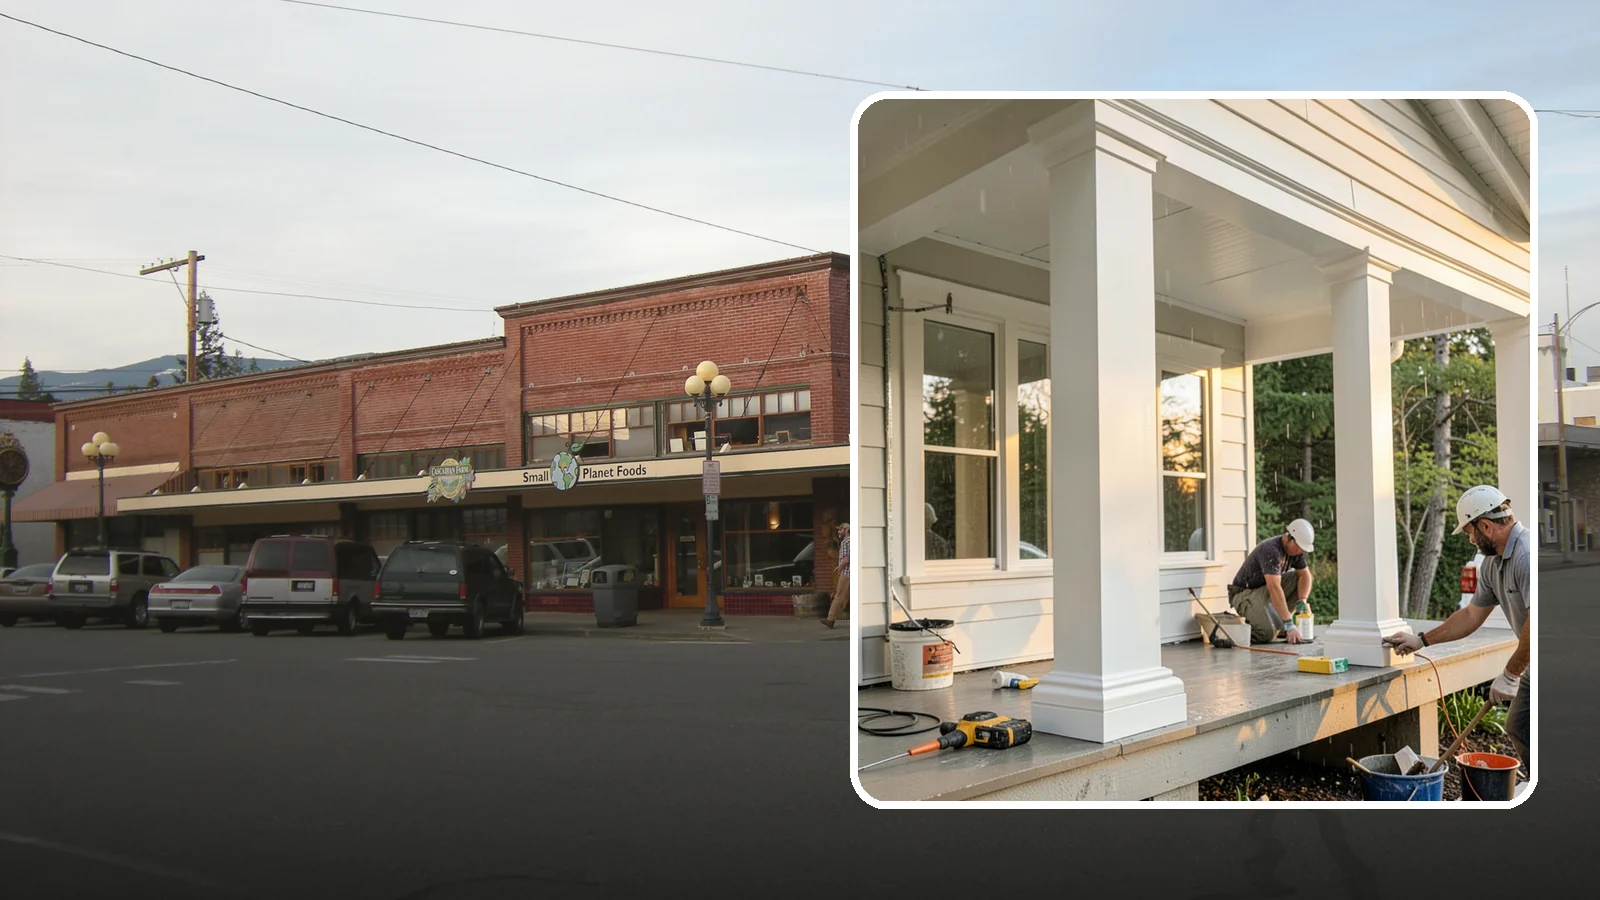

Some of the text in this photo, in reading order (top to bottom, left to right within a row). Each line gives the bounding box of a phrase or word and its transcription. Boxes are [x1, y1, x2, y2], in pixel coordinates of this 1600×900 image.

[523, 464, 647, 483] Small Planet Foods
